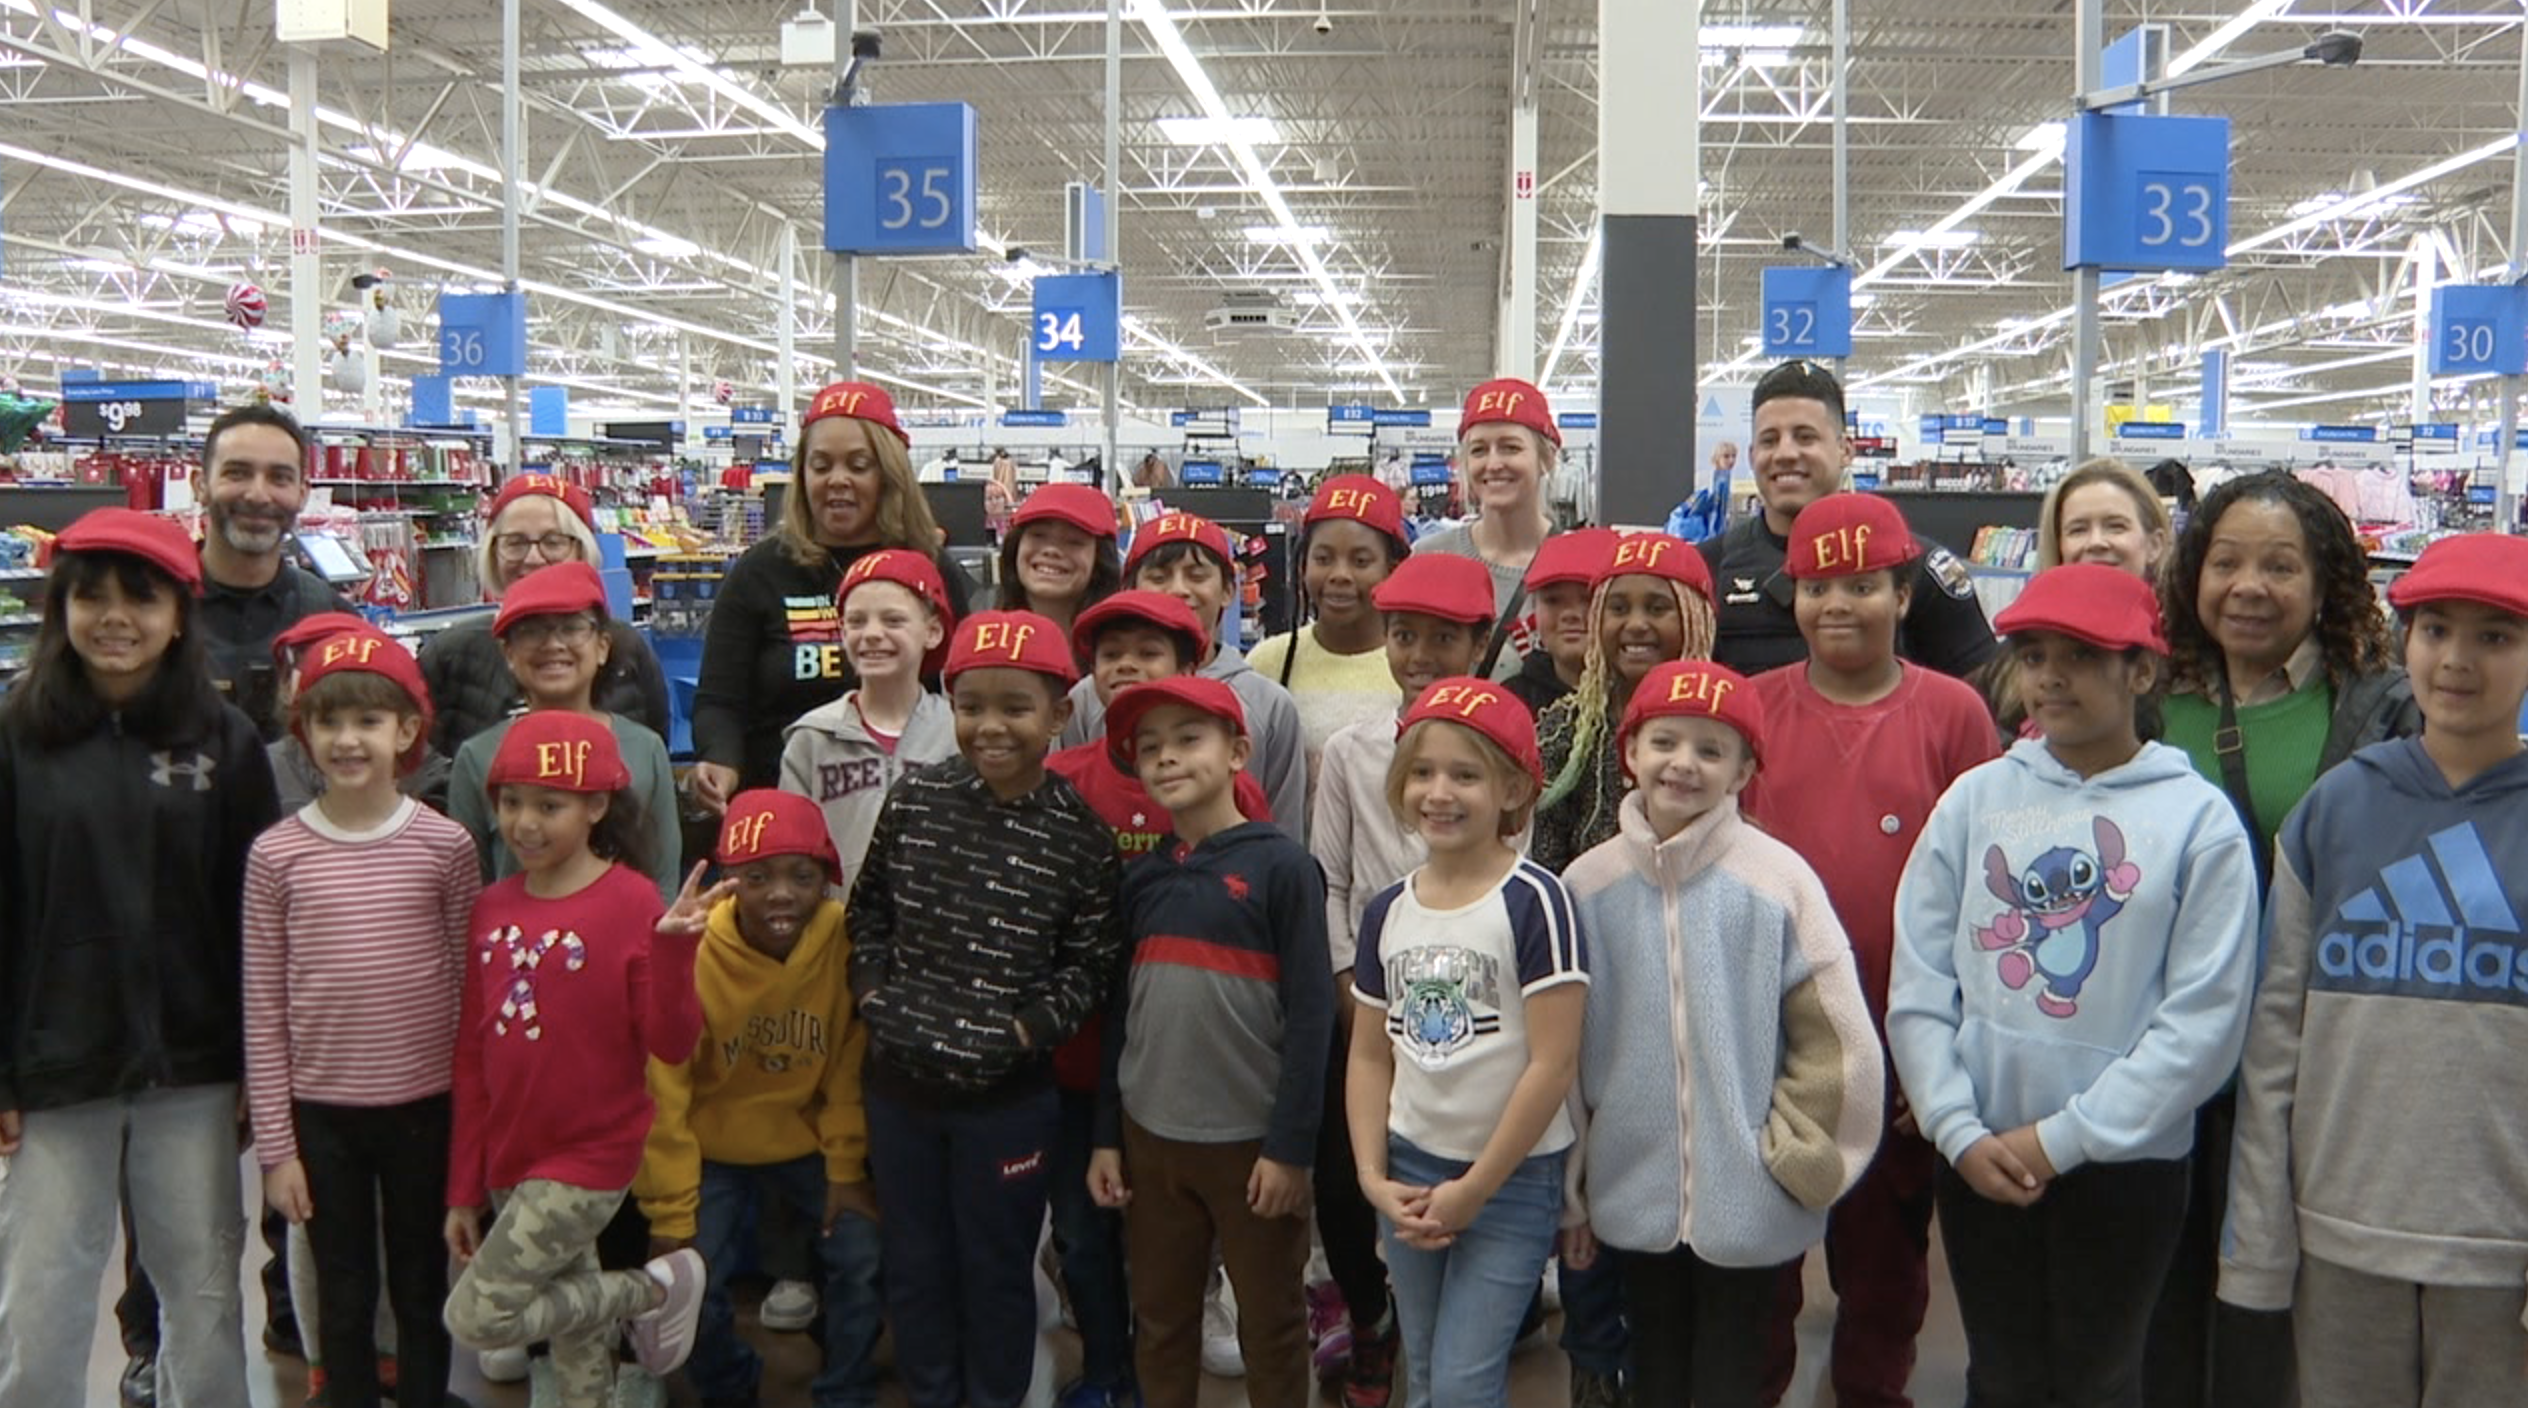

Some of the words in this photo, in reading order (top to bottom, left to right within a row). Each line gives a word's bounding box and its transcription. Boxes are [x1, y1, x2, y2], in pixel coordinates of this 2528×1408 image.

[882, 168, 951, 230] 35
[2141, 182, 2212, 247] 33
[1040, 313, 1084, 351] 34
[1769, 308, 1814, 346] 32
[2447, 325, 2494, 362] 30
[446, 331, 483, 367] 36
[821, 390, 869, 415] Elf
[1478, 391, 1525, 416] Elf
[526, 475, 569, 499] Elf
[1327, 488, 1377, 516] Elf
[1157, 513, 1206, 540] Elf
[1613, 538, 1672, 568] Elf
[1813, 525, 1872, 570] Elf
[322, 636, 383, 667] Elf
[974, 622, 1036, 661] Elf
[796, 644, 842, 679] BE
[1425, 685, 1498, 717] Elf
[1668, 672, 1734, 714] Elf
[536, 740, 592, 786] Elf
[727, 812, 775, 855] Elf
